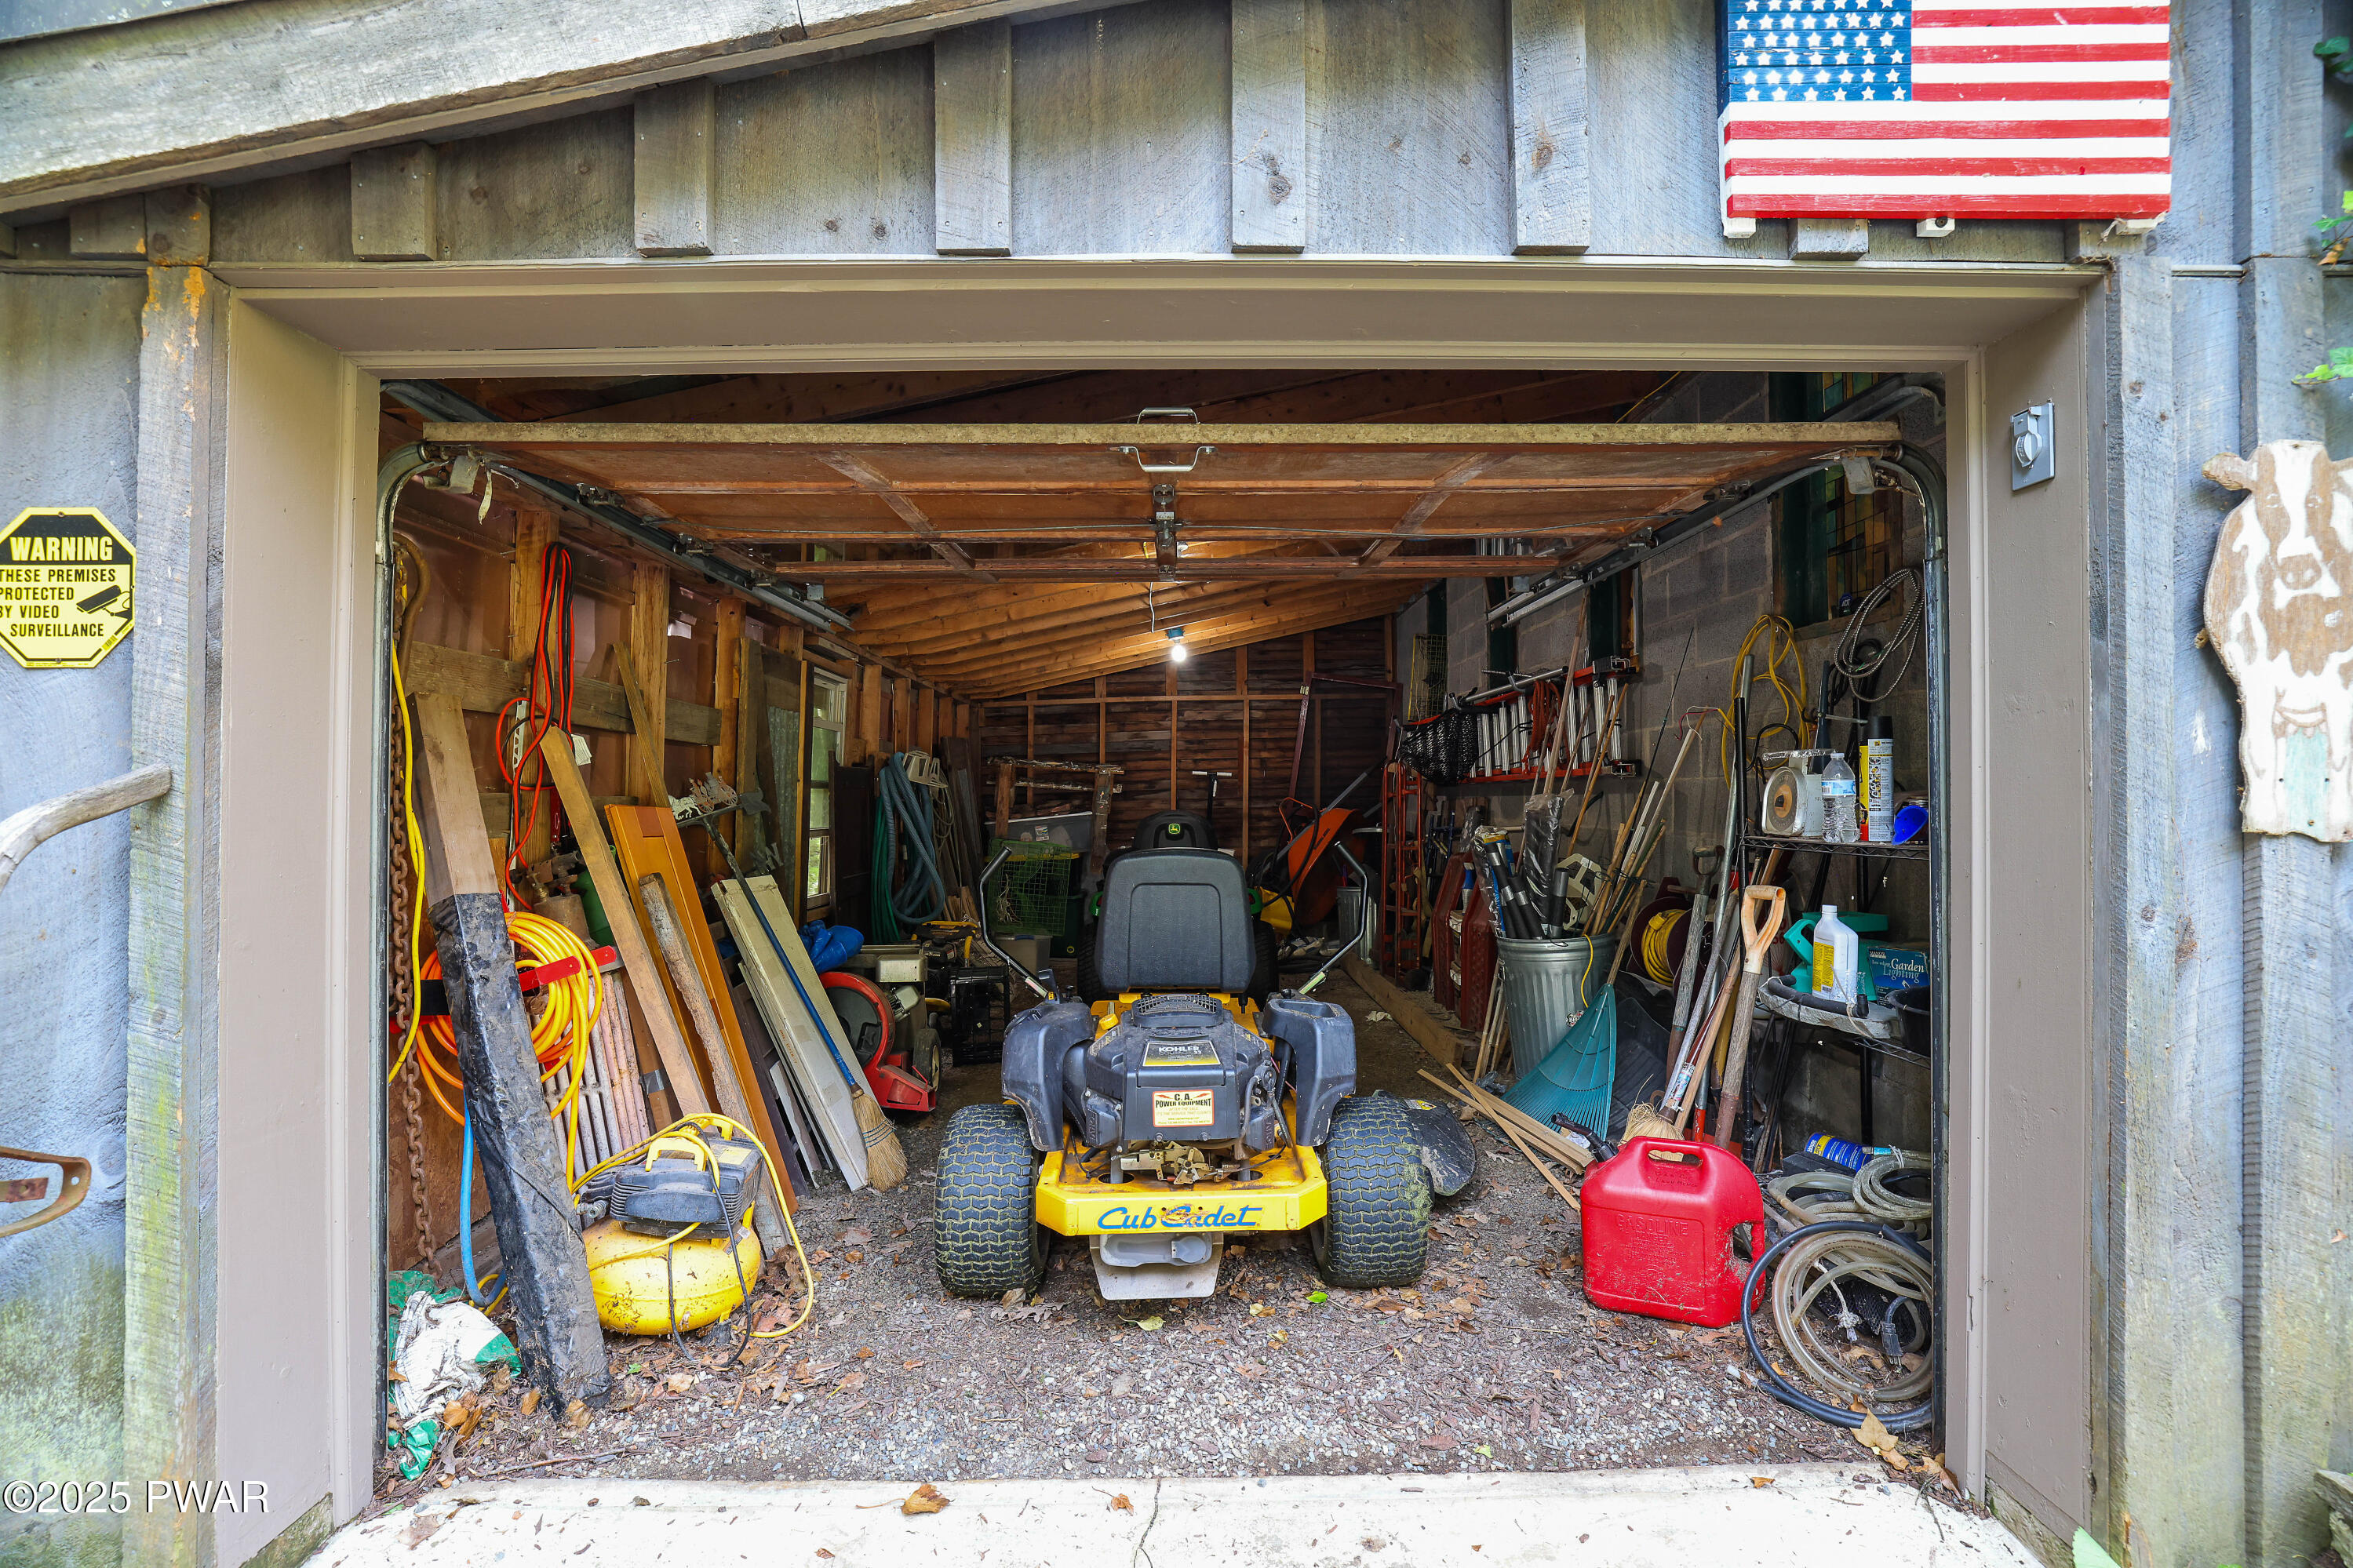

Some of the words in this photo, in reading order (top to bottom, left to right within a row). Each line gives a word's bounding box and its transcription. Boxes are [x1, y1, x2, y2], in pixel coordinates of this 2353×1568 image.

[9, 536, 113, 562] WARNING
[0, 569, 40, 582] THESE
[49, 569, 115, 582] PREMISES
[20, 605, 59, 618] VIDEO
[10, 623, 104, 637] SURVEILLANCE
[1891, 958, 1925, 973] Garden
[1883, 964, 1920, 984] Lighting
[1155, 1100, 1177, 1108] POWER
[1178, 1098, 1211, 1107] EQUIPMENT
[1097, 1206, 1157, 1230] Cub
[1615, 1213, 1688, 1236] GASOLINE
